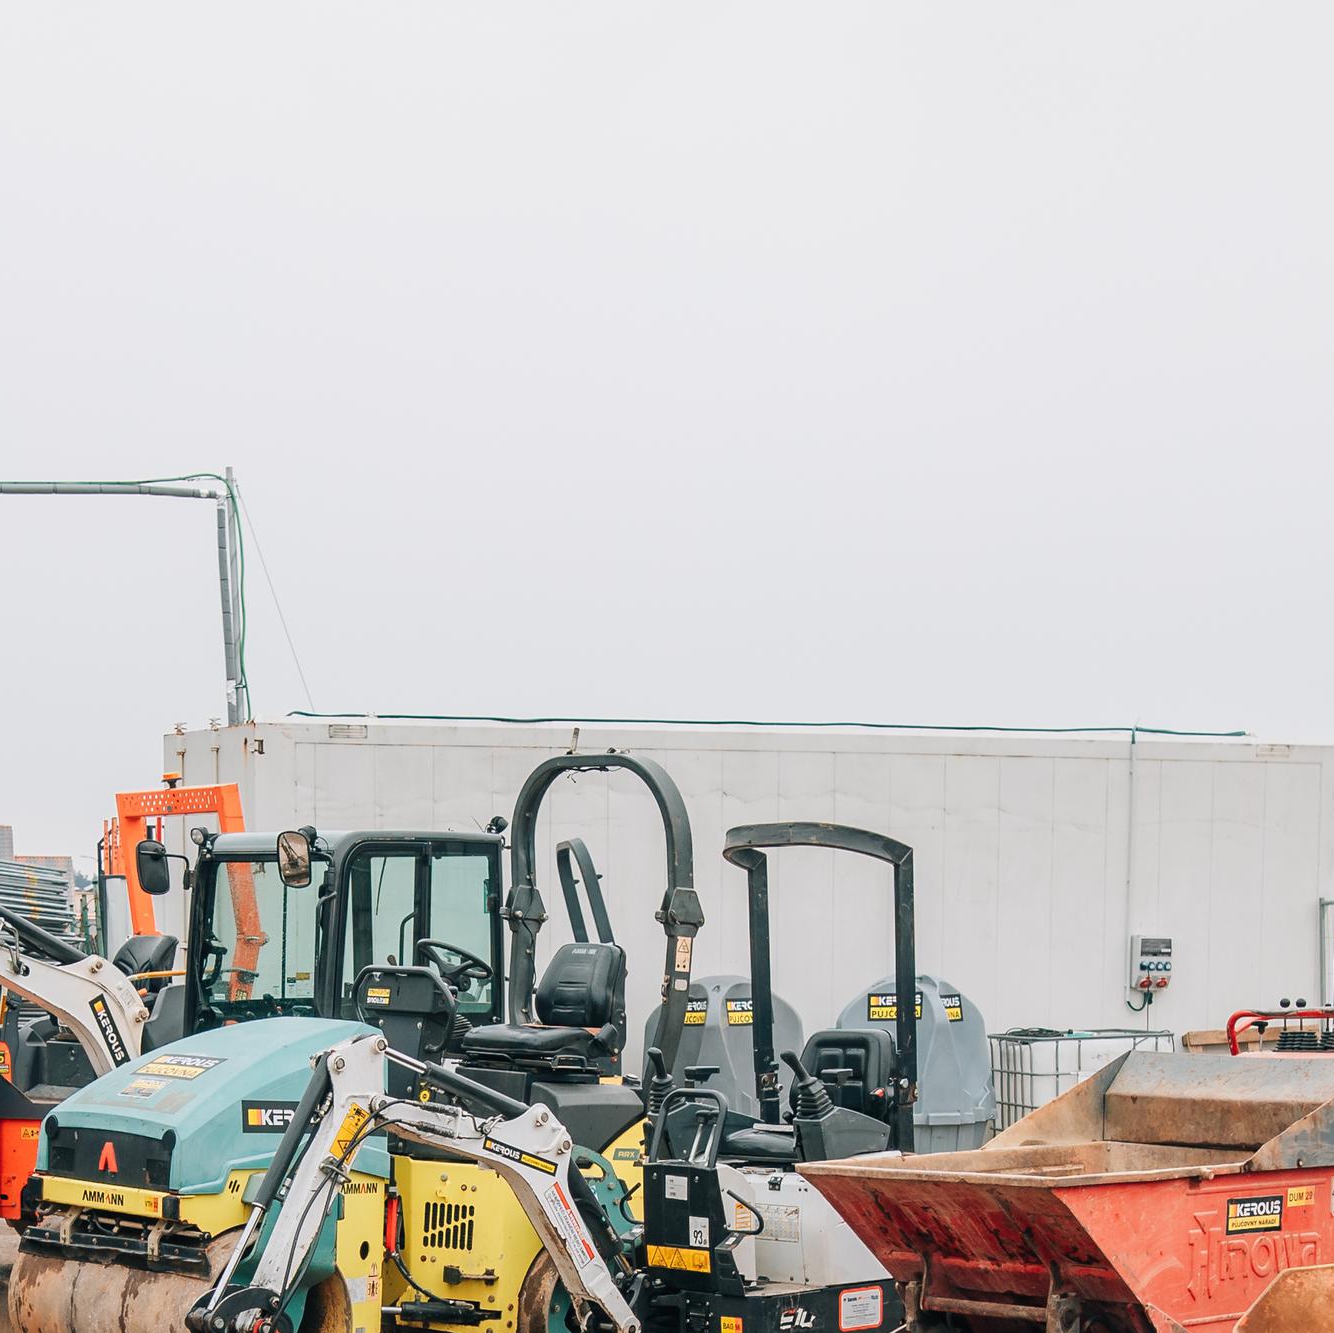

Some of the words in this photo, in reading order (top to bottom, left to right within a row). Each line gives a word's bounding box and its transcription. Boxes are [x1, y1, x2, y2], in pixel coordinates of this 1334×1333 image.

[260, 1109, 296, 1126] KER
[341, 1183, 378, 1194] AMMANN
[82, 1189, 124, 1206] AMMANN
[1289, 1192, 1304, 1202] DUM
